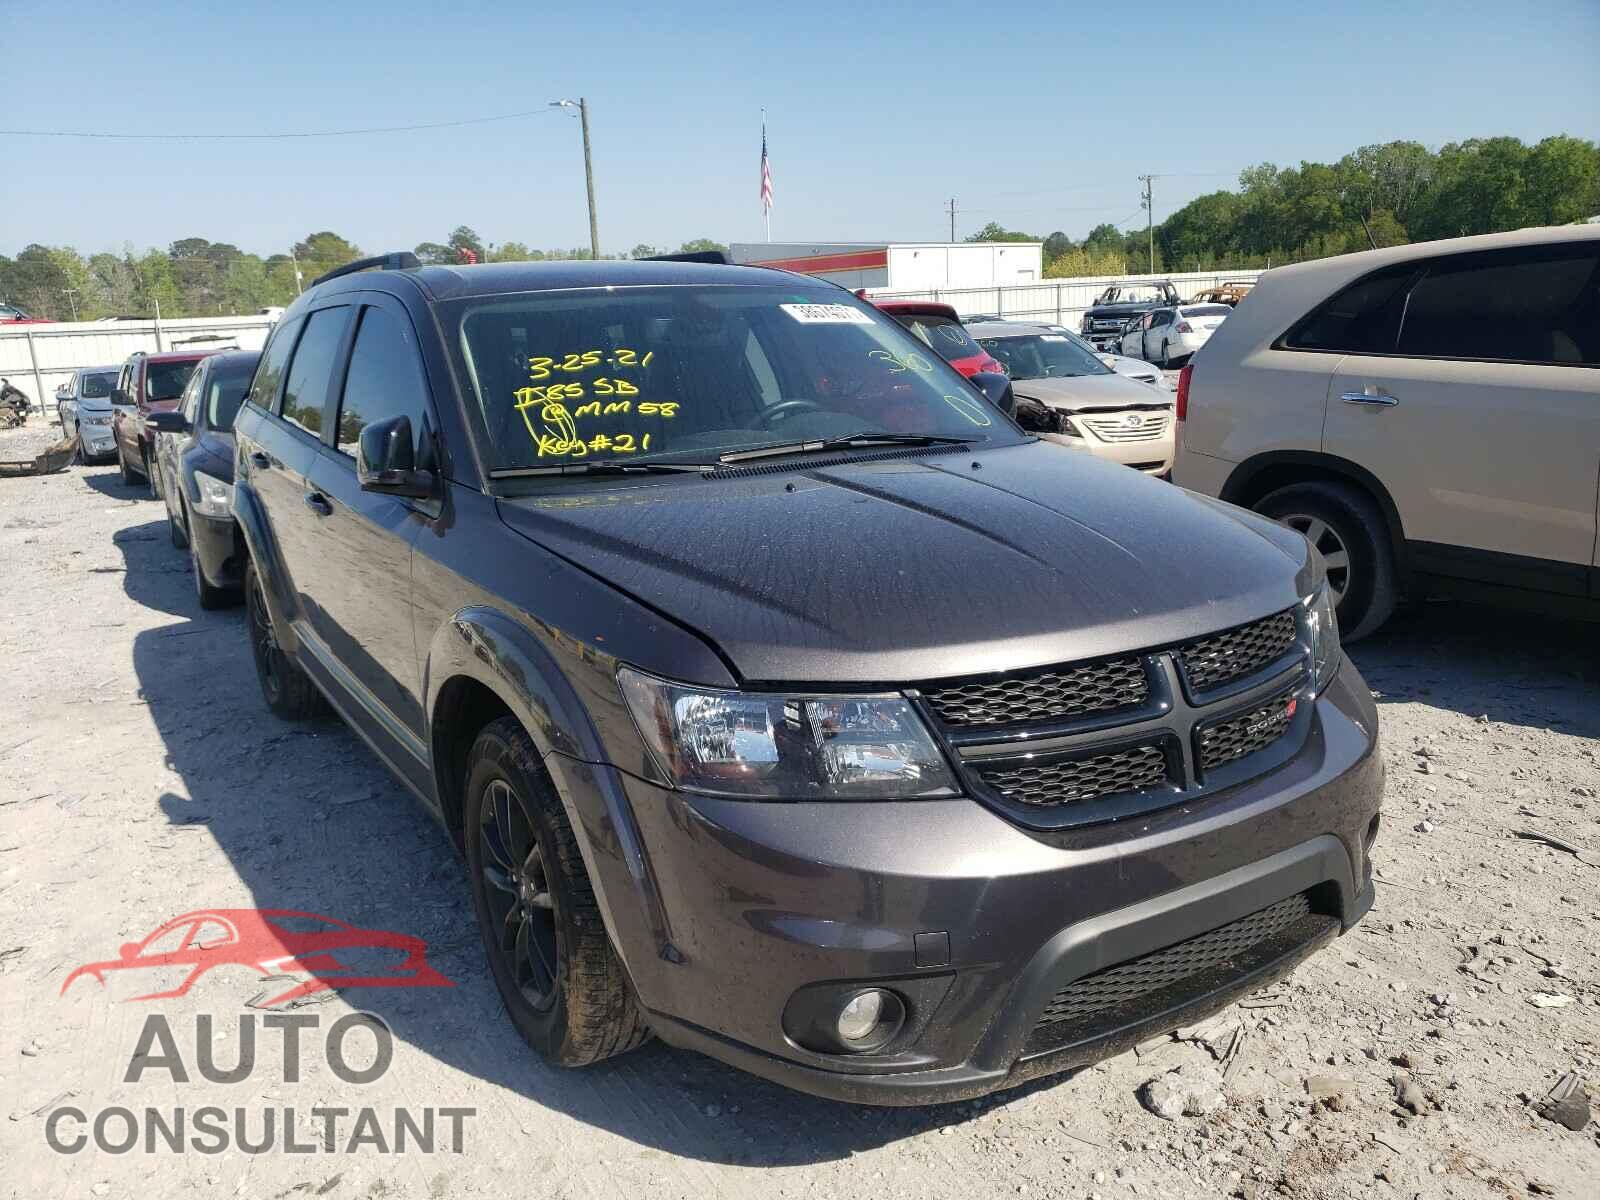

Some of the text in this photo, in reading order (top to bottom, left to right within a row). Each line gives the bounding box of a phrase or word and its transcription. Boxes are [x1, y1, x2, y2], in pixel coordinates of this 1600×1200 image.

[593, 378, 639, 394] SB
[575, 401, 631, 417] MM
[638, 402, 680, 416] 58
